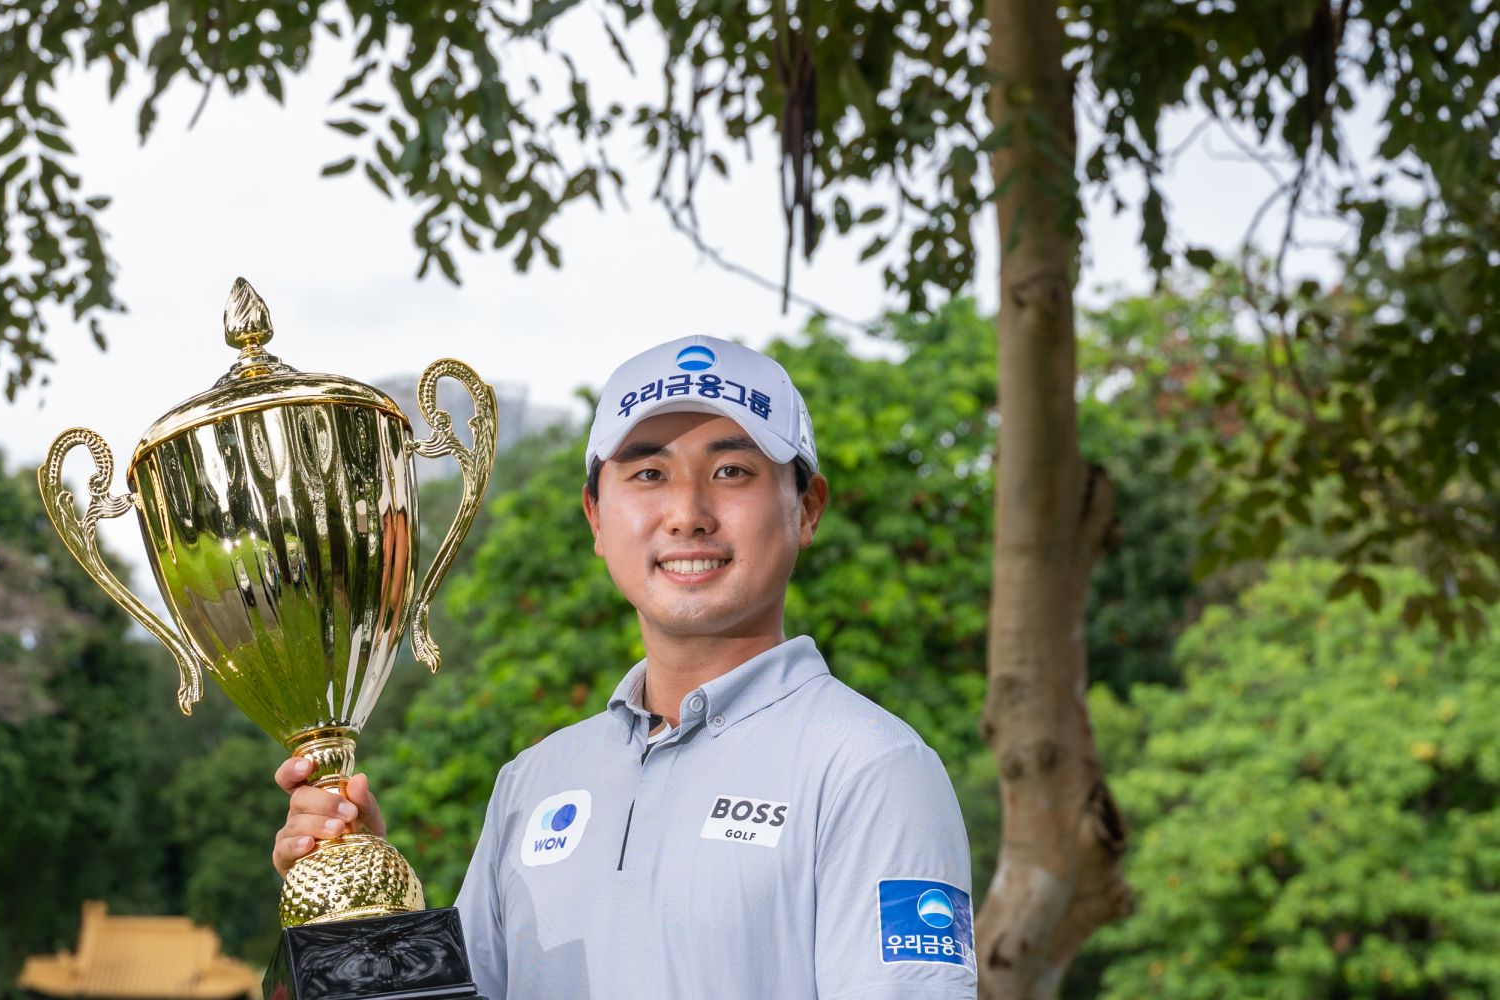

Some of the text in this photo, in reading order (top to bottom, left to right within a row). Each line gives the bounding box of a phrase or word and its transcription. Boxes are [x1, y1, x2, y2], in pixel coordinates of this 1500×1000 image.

[617, 373, 773, 421] 우리금융그룹
[710, 798, 788, 827] BOSS
[533, 836, 568, 852] WON
[725, 829, 757, 841] GOLF
